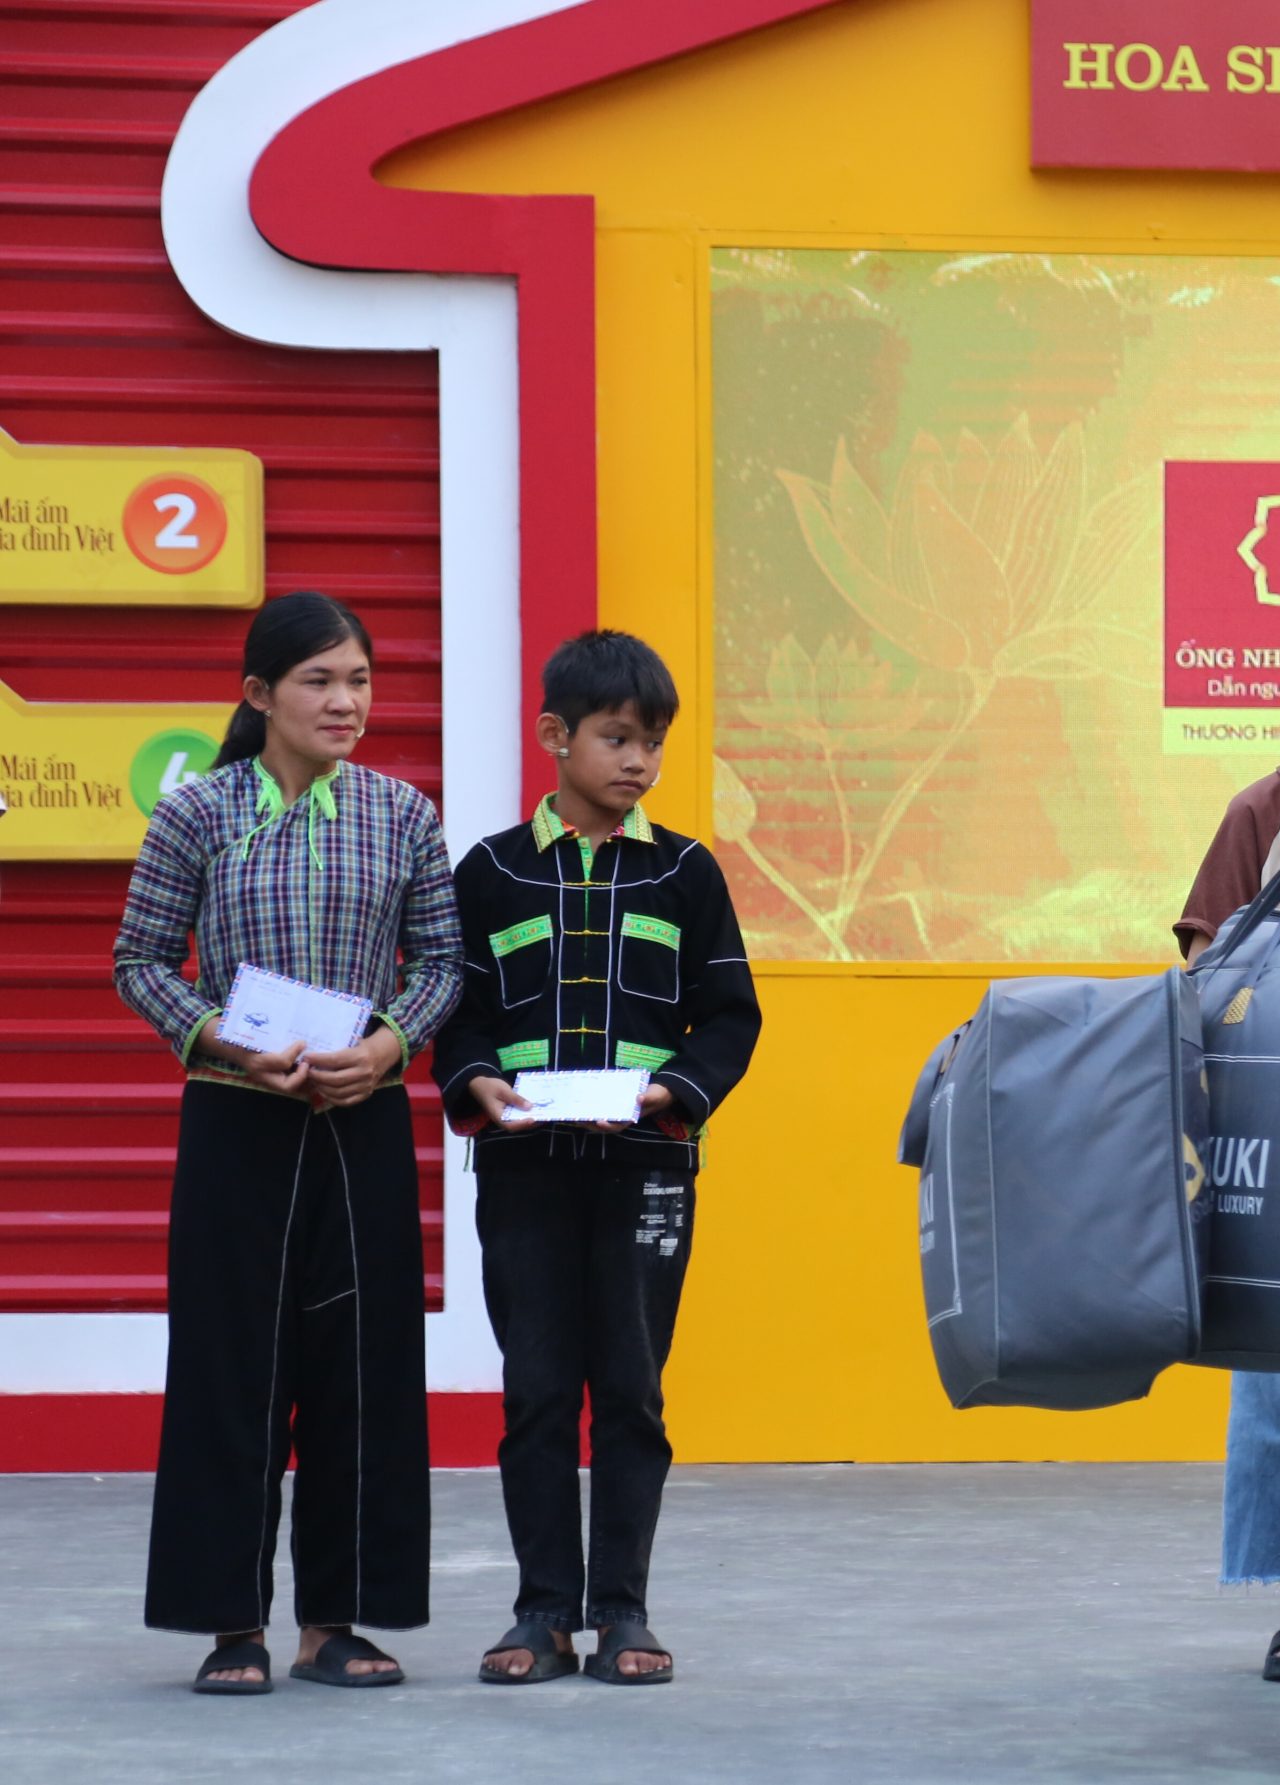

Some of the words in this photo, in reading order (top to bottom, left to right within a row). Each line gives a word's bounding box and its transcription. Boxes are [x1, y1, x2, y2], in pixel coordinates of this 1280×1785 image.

[1062, 42, 1209, 92] HOA
[153, 493, 200, 550] 2
[74, 525, 115, 556] Việt
[1175, 638, 1235, 669] ỐNG
[159, 751, 198, 794] 4
[82, 781, 122, 812] Việt
[1217, 1193, 1265, 1216] LUXURY
